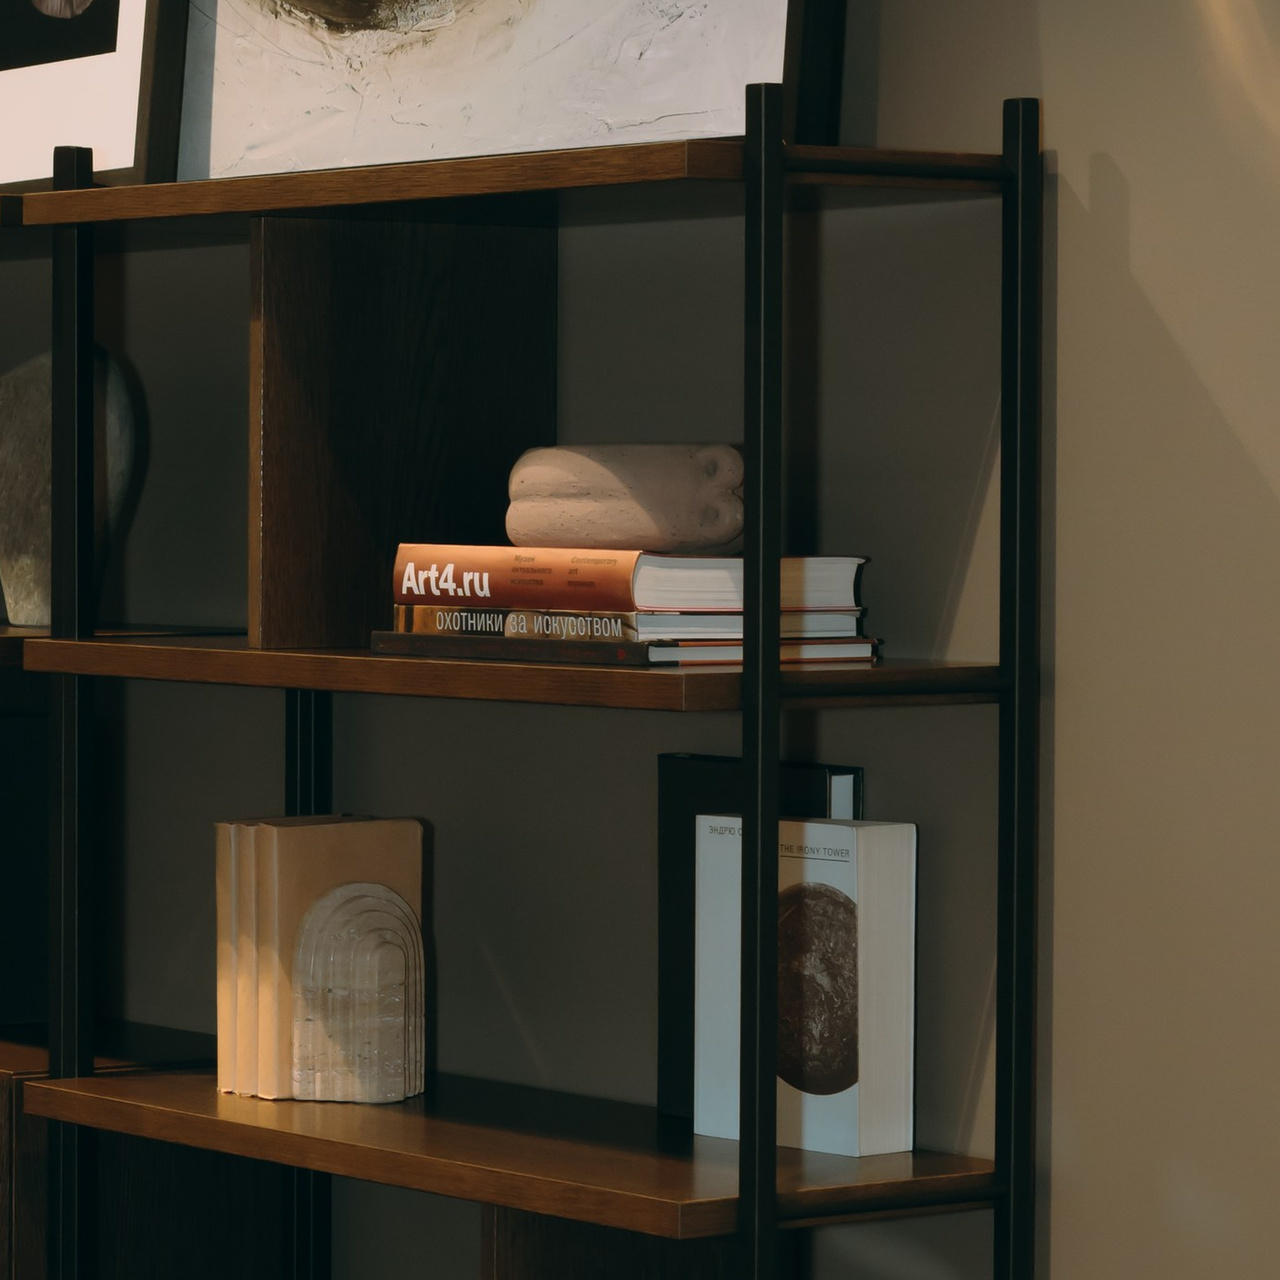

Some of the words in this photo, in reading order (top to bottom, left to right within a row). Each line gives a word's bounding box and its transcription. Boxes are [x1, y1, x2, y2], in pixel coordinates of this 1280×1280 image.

[401, 562, 491, 597] Art4.ru
[435, 610, 504, 632] охотники
[509, 612, 528, 633] за
[533, 614, 623, 640] искусством
[708, 825, 736, 836] ЭНДРЮ
[780, 843, 795, 854] THE
[795, 844, 821, 856] IRONY
[823, 847, 850, 858] TOWER
